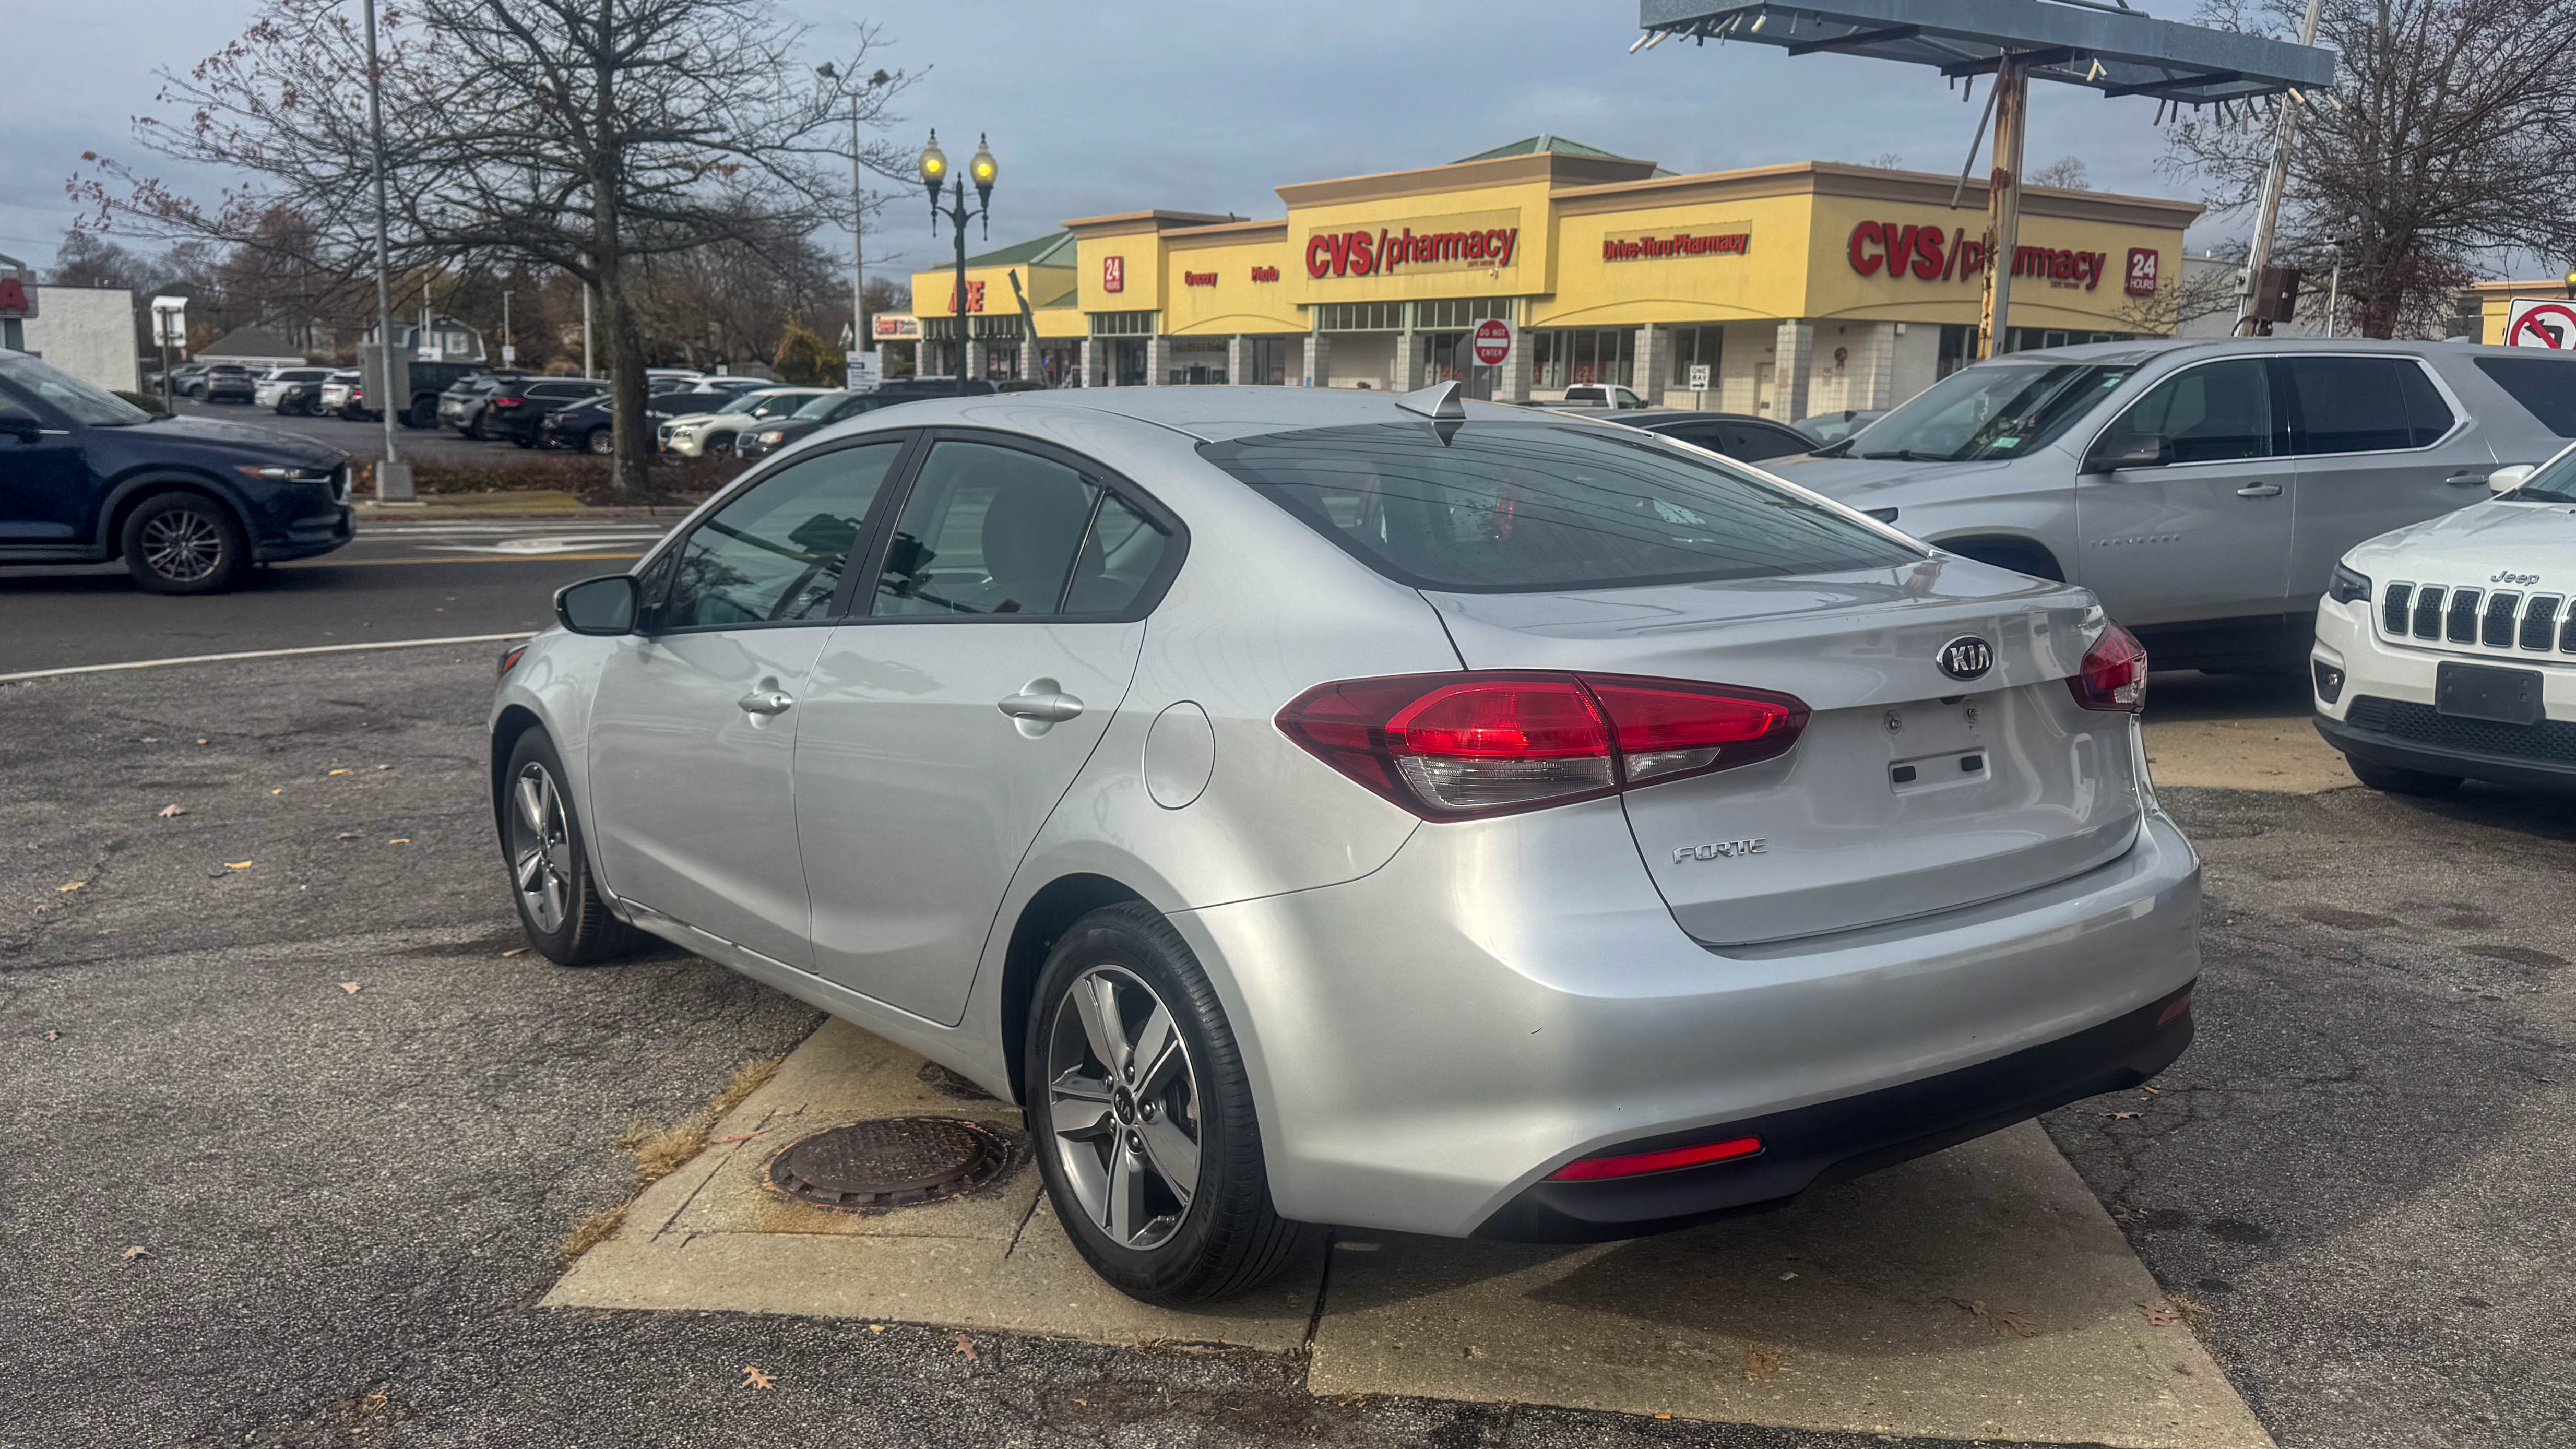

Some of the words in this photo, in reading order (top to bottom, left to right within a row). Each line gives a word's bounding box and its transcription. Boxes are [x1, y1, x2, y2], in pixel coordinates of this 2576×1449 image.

[1603, 237, 1672, 259] Drive-Thru
[1673, 234, 1749, 255] Pharmacy
[1106, 258, 1119, 280] 24
[2132, 254, 2155, 278] 24
[2130, 278, 2154, 290] HOURS
[1479, 328, 1489, 337] DO
[1492, 328, 1505, 337] NOT
[1481, 348, 1502, 357] ENTER
[2490, 570, 2539, 586] Jeep
[1950, 644, 1989, 672] KIA
[1673, 837, 1768, 864] FORTE
